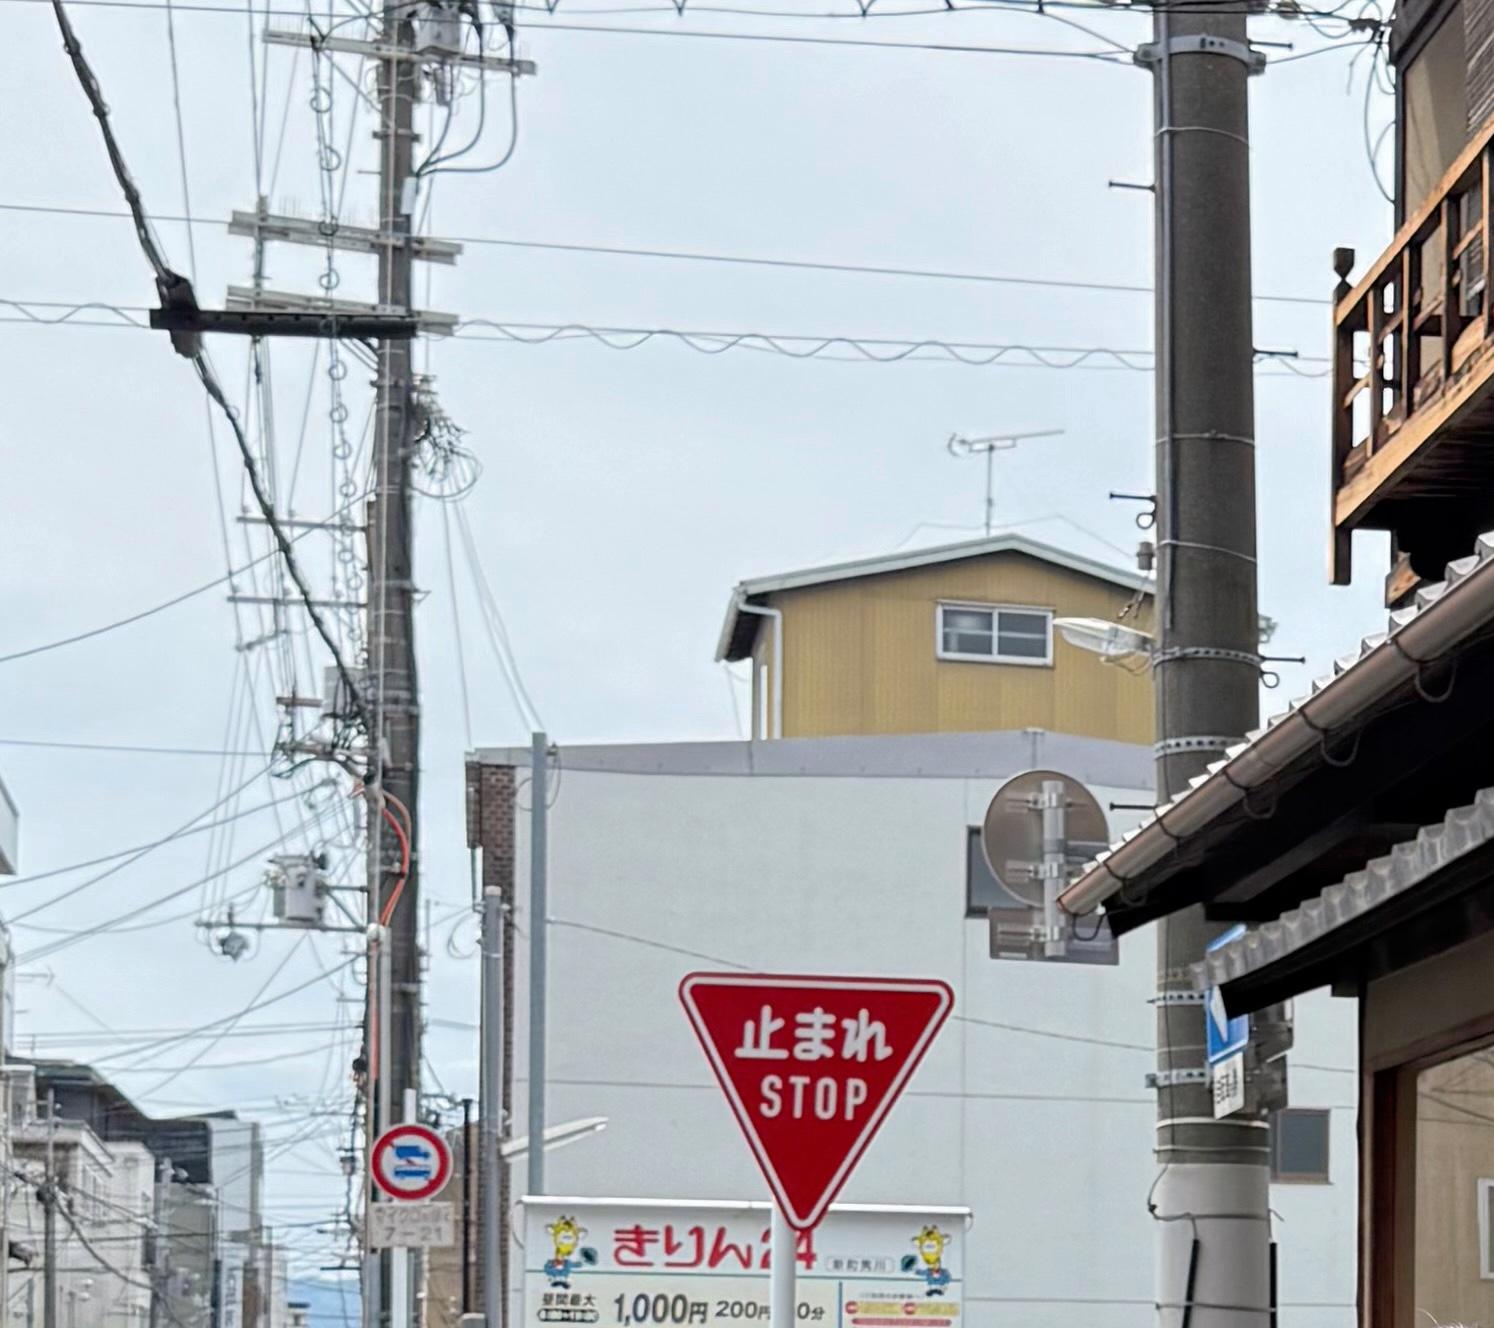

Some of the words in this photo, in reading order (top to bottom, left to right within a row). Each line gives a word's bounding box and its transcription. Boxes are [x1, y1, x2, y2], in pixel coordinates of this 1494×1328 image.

[734, 1004, 893, 1062] 止まれ
[760, 1074, 868, 1121] STOP
[612, 1224, 817, 1270] きりん4
[614, 1293, 709, 1326] 1,000円
[796, 1302, 825, 1320] 0分
